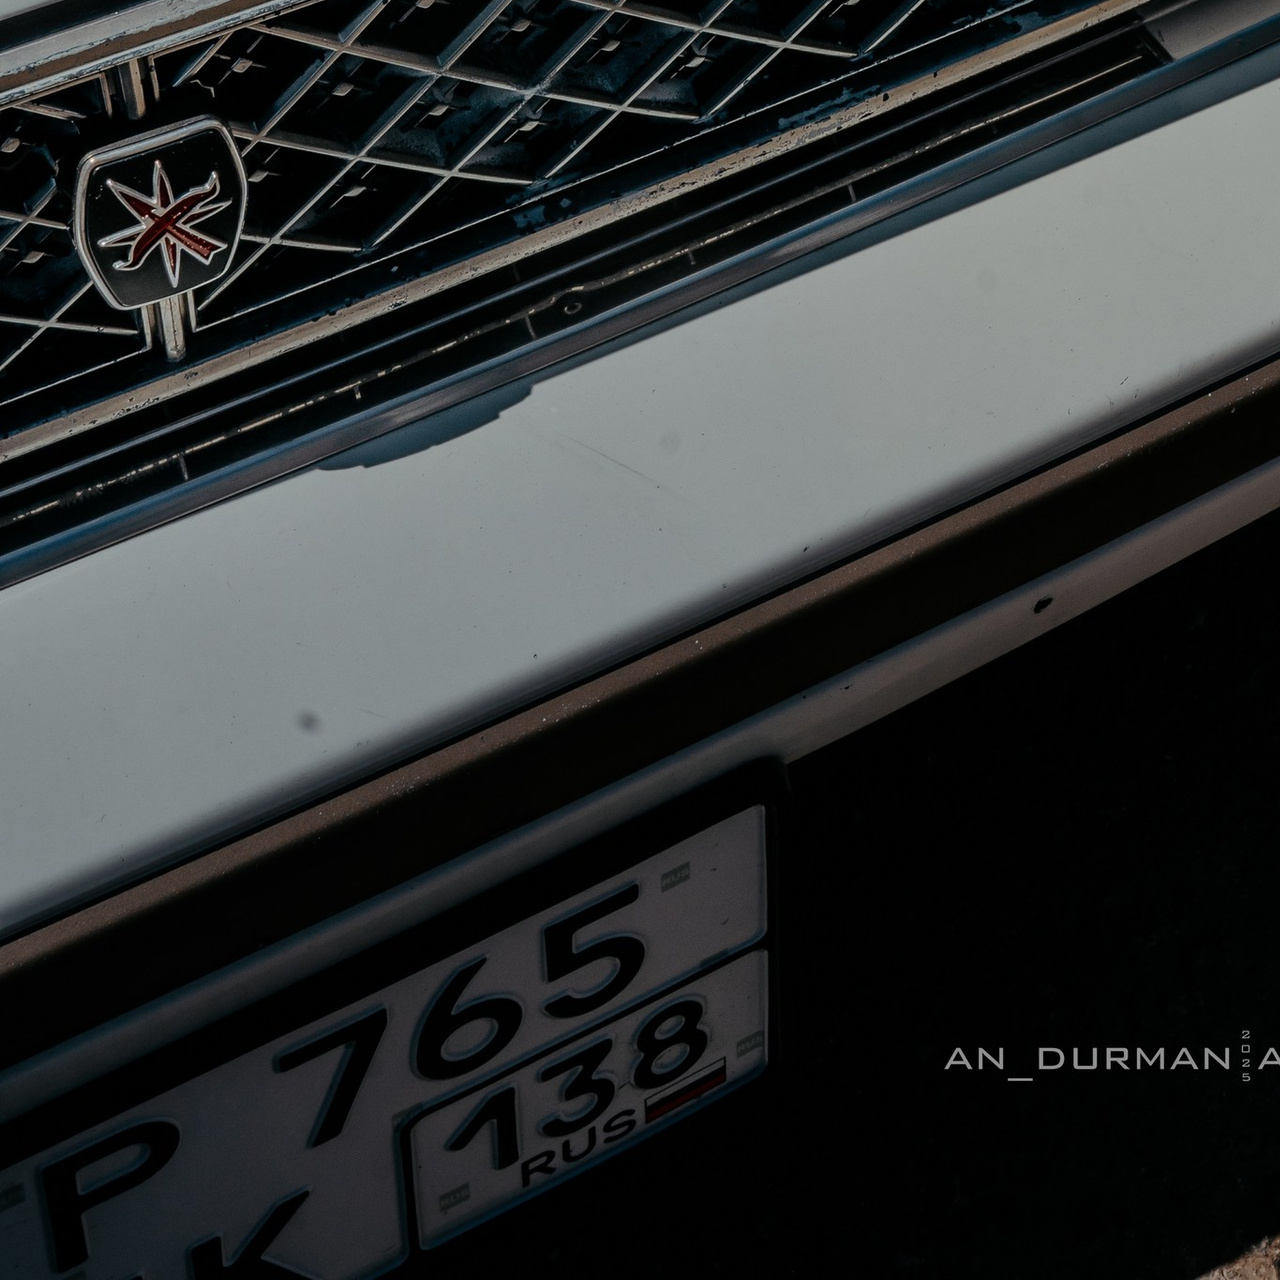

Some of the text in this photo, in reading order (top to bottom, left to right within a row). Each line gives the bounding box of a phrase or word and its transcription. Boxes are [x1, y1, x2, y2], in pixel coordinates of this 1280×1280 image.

[273, 882, 648, 1149] 765
[446, 995, 710, 1172] 138
[520, 1108, 638, 1189] RUS
